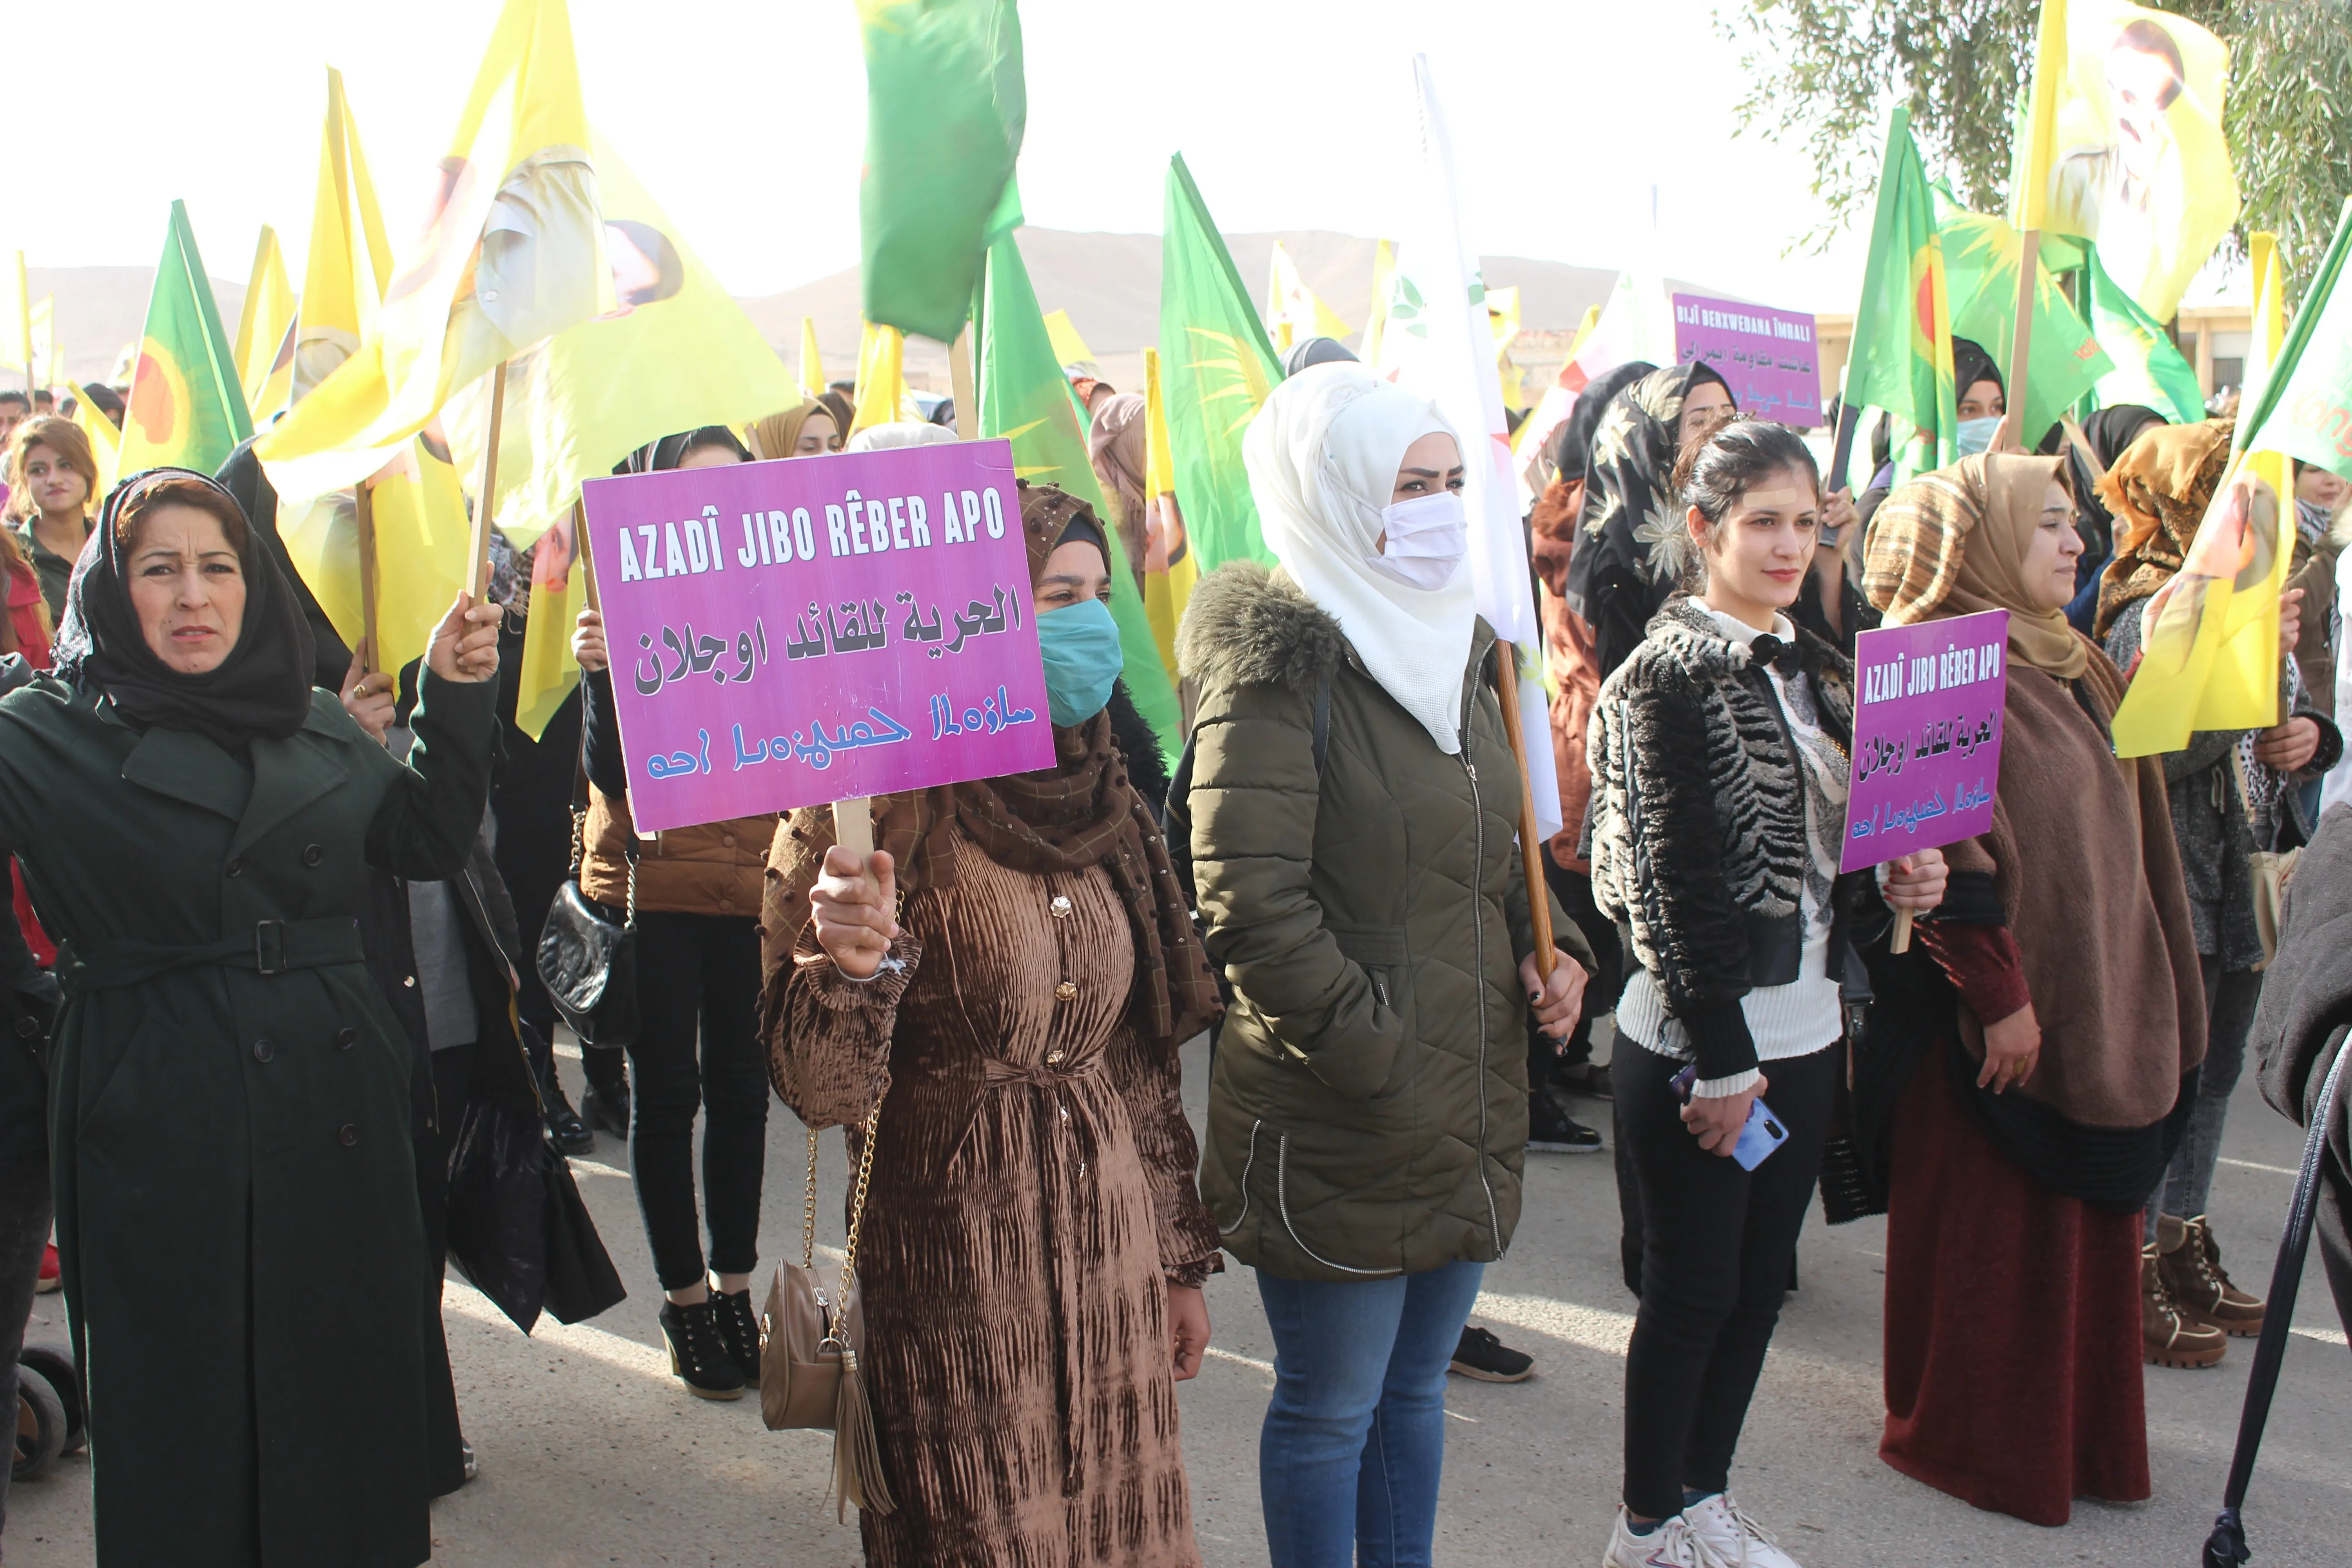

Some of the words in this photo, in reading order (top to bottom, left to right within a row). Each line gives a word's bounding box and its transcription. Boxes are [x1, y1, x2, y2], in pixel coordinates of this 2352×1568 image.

[1701, 309, 1771, 337] BERXWEDANA
[1772, 317, 1810, 343] ÎMRALI
[1732, 345, 1773, 370] مقاومة
[618, 504, 725, 583] AZADÎ
[737, 506, 816, 569] JIBO
[825, 489, 933, 558] RÊBER
[944, 486, 1006, 545] APO
[786, 598, 888, 661] للقائد
[895, 583, 1022, 659] الحرية
[634, 616, 768, 696] اوجلان
[1864, 652, 1905, 705] AZADÎ
[1907, 655, 1936, 696] JIBO
[1940, 643, 1975, 690] RÊBER
[1978, 642, 2000, 681] APO
[1858, 729, 1911, 783] اوجلان
[1915, 718, 1954, 760] للقائد
[1955, 708, 1998, 760] الحرية
